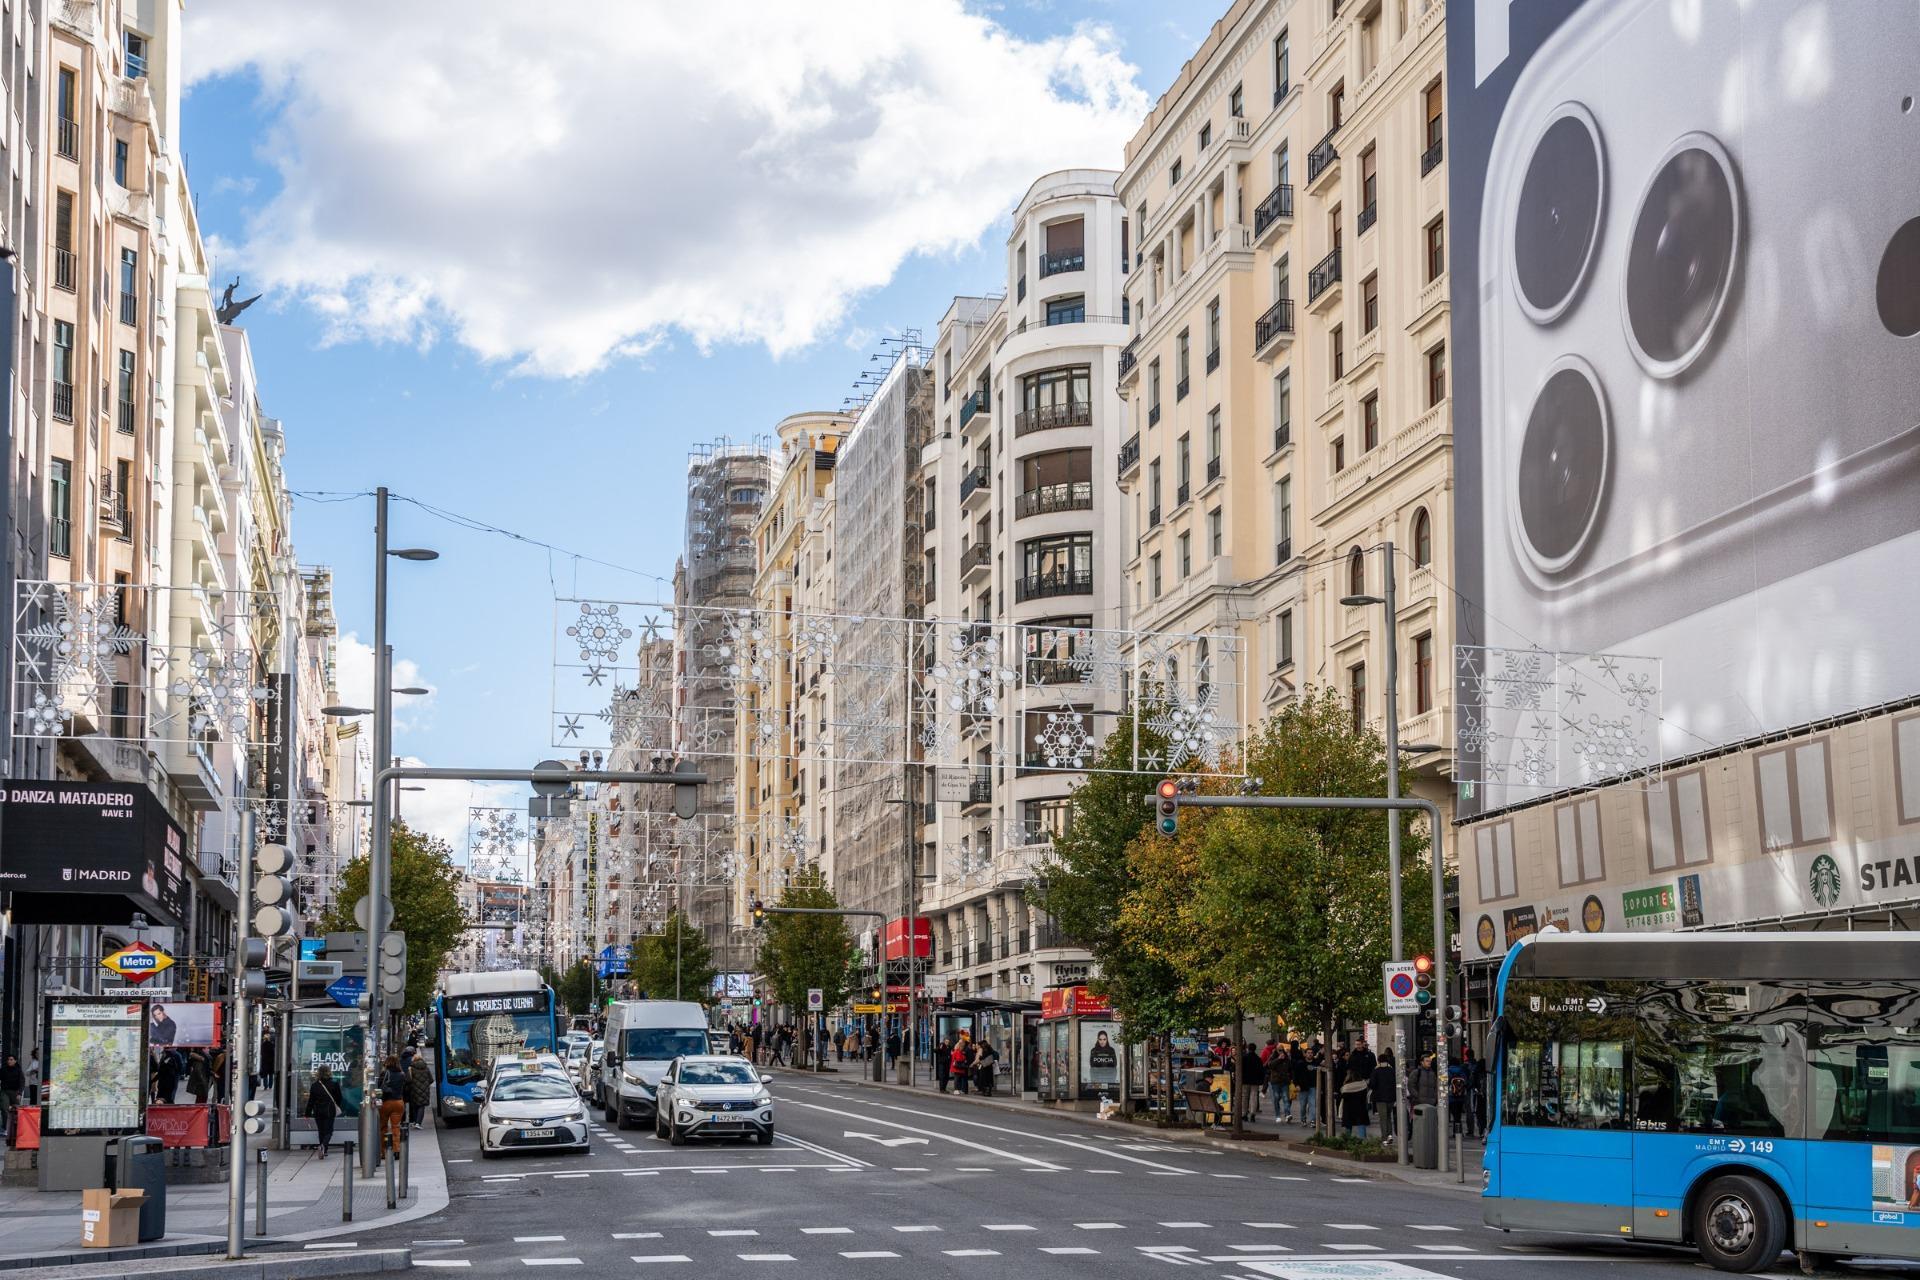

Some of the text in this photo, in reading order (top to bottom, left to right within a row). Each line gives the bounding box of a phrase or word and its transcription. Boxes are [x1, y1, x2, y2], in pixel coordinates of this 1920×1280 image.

[11, 790, 56, 804] DANZA
[59, 791, 134, 807] MATADERO
[101, 808, 133, 818] NAVE 11
[79, 869, 132, 881] MADRID
[1624, 891, 1674, 912] SOPORTES
[123, 956, 154, 966] Metro
[1055, 964, 1088, 977] flying
[108, 988, 168, 998] Plaza de España
[455, 999, 469, 1013] 44
[473, 999, 503, 1012] MARQUES
[504, 997, 513, 1010] DE
[1565, 997, 1584, 1005] EMT
[1548, 1004, 1584, 1012] MADRID
[311, 1052, 346, 1062] BLACK
[1749, 1141, 1774, 1153] 149
[1879, 1213, 1898, 1222] global
